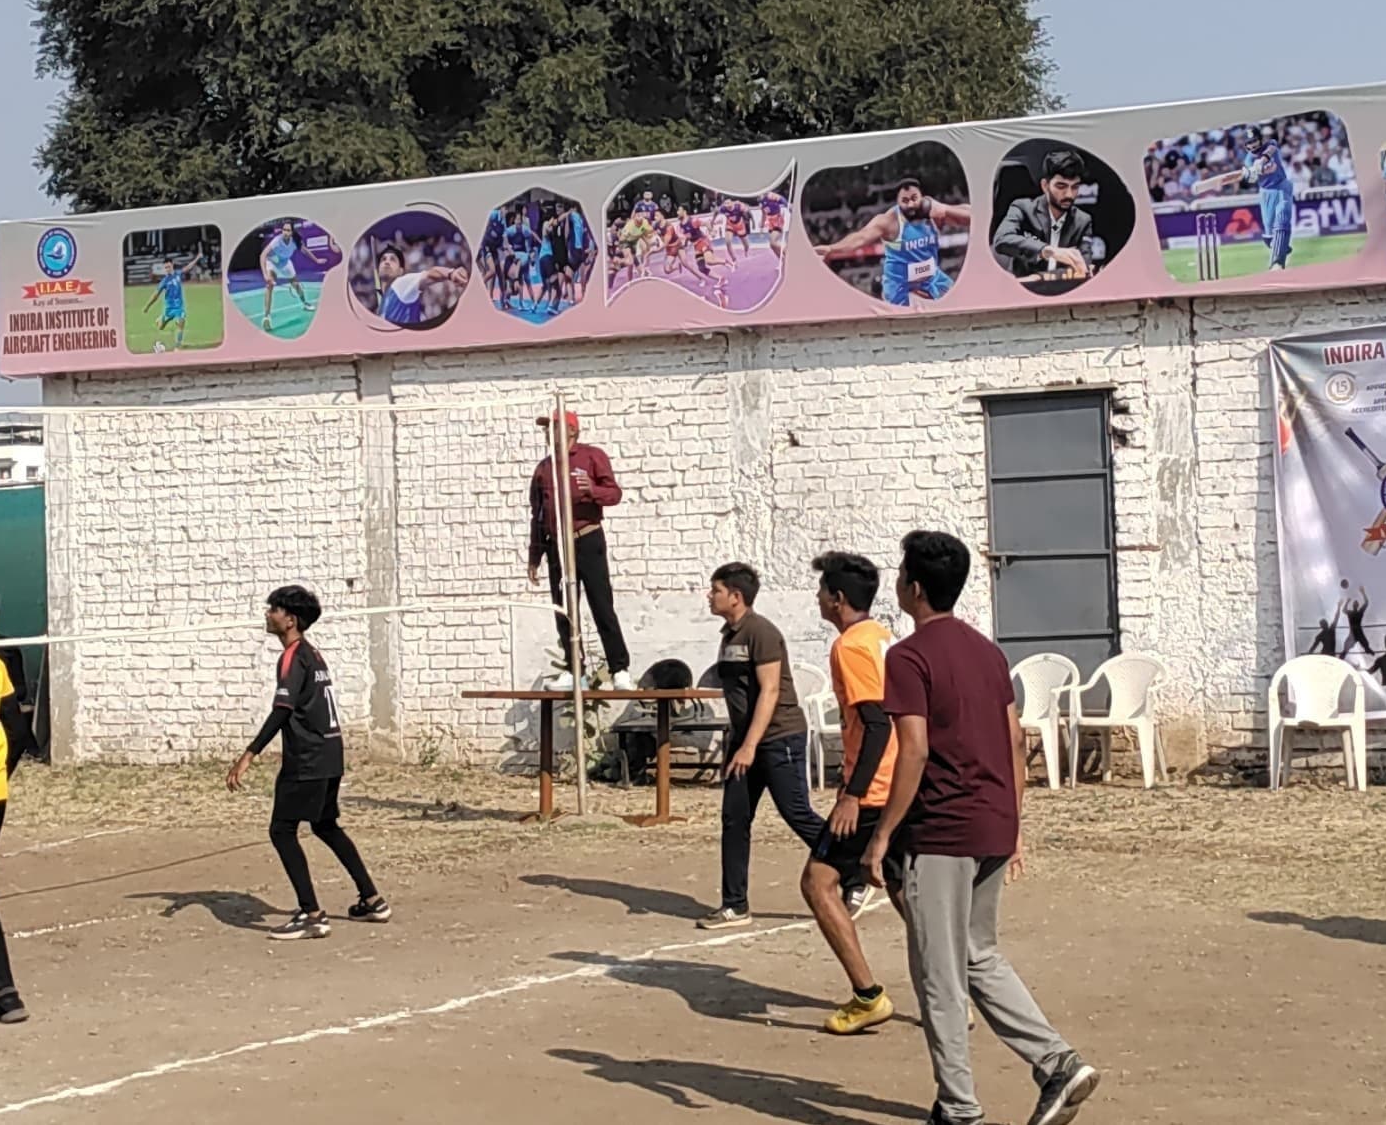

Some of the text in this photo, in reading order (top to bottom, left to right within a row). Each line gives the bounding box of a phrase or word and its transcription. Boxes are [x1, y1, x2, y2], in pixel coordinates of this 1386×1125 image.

[905, 234, 935, 250] INDIA
[9, 307, 109, 332] INDIRA INSTITUTE OF
[3, 329, 117, 354] AIRCRAFT ENGINEERING
[1323, 342, 1385, 365] INDIRA
